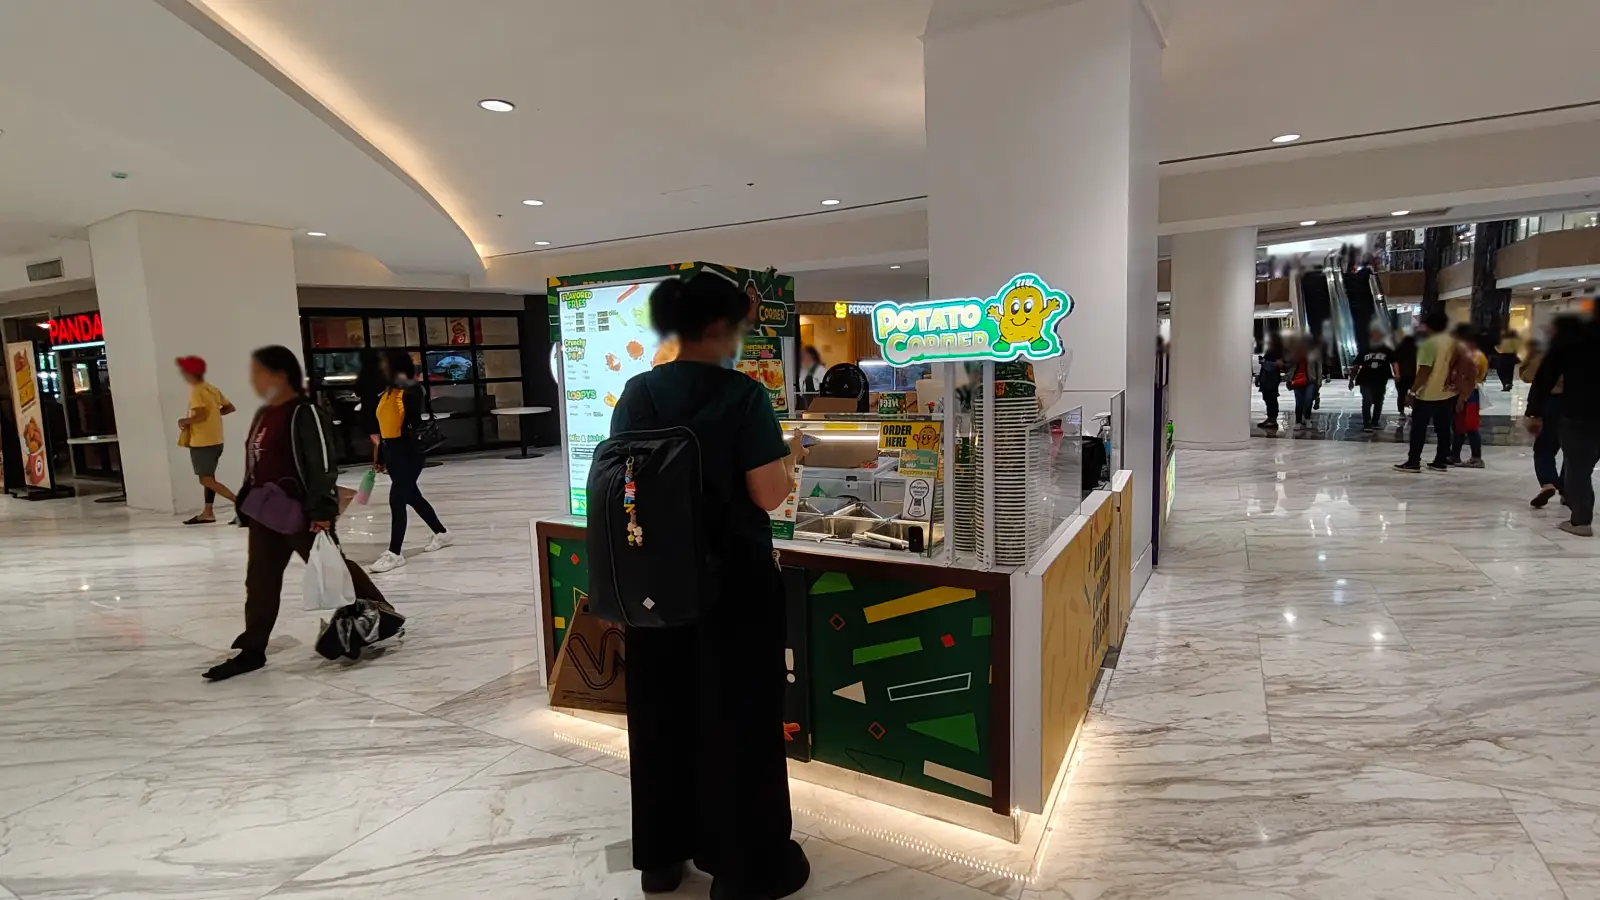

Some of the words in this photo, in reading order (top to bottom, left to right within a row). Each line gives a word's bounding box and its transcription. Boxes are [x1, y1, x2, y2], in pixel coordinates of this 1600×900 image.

[561, 291, 593, 302] FLAVORED
[567, 299, 587, 309] FRIES
[759, 305, 785, 321] CORNER
[876, 305, 981, 338] POTATO
[49, 313, 104, 343] PANDA
[886, 332, 990, 364] CORNER
[567, 390, 596, 400] LOOPYS
[883, 424, 912, 436] ORDER
[885, 436, 907, 448] HERE
